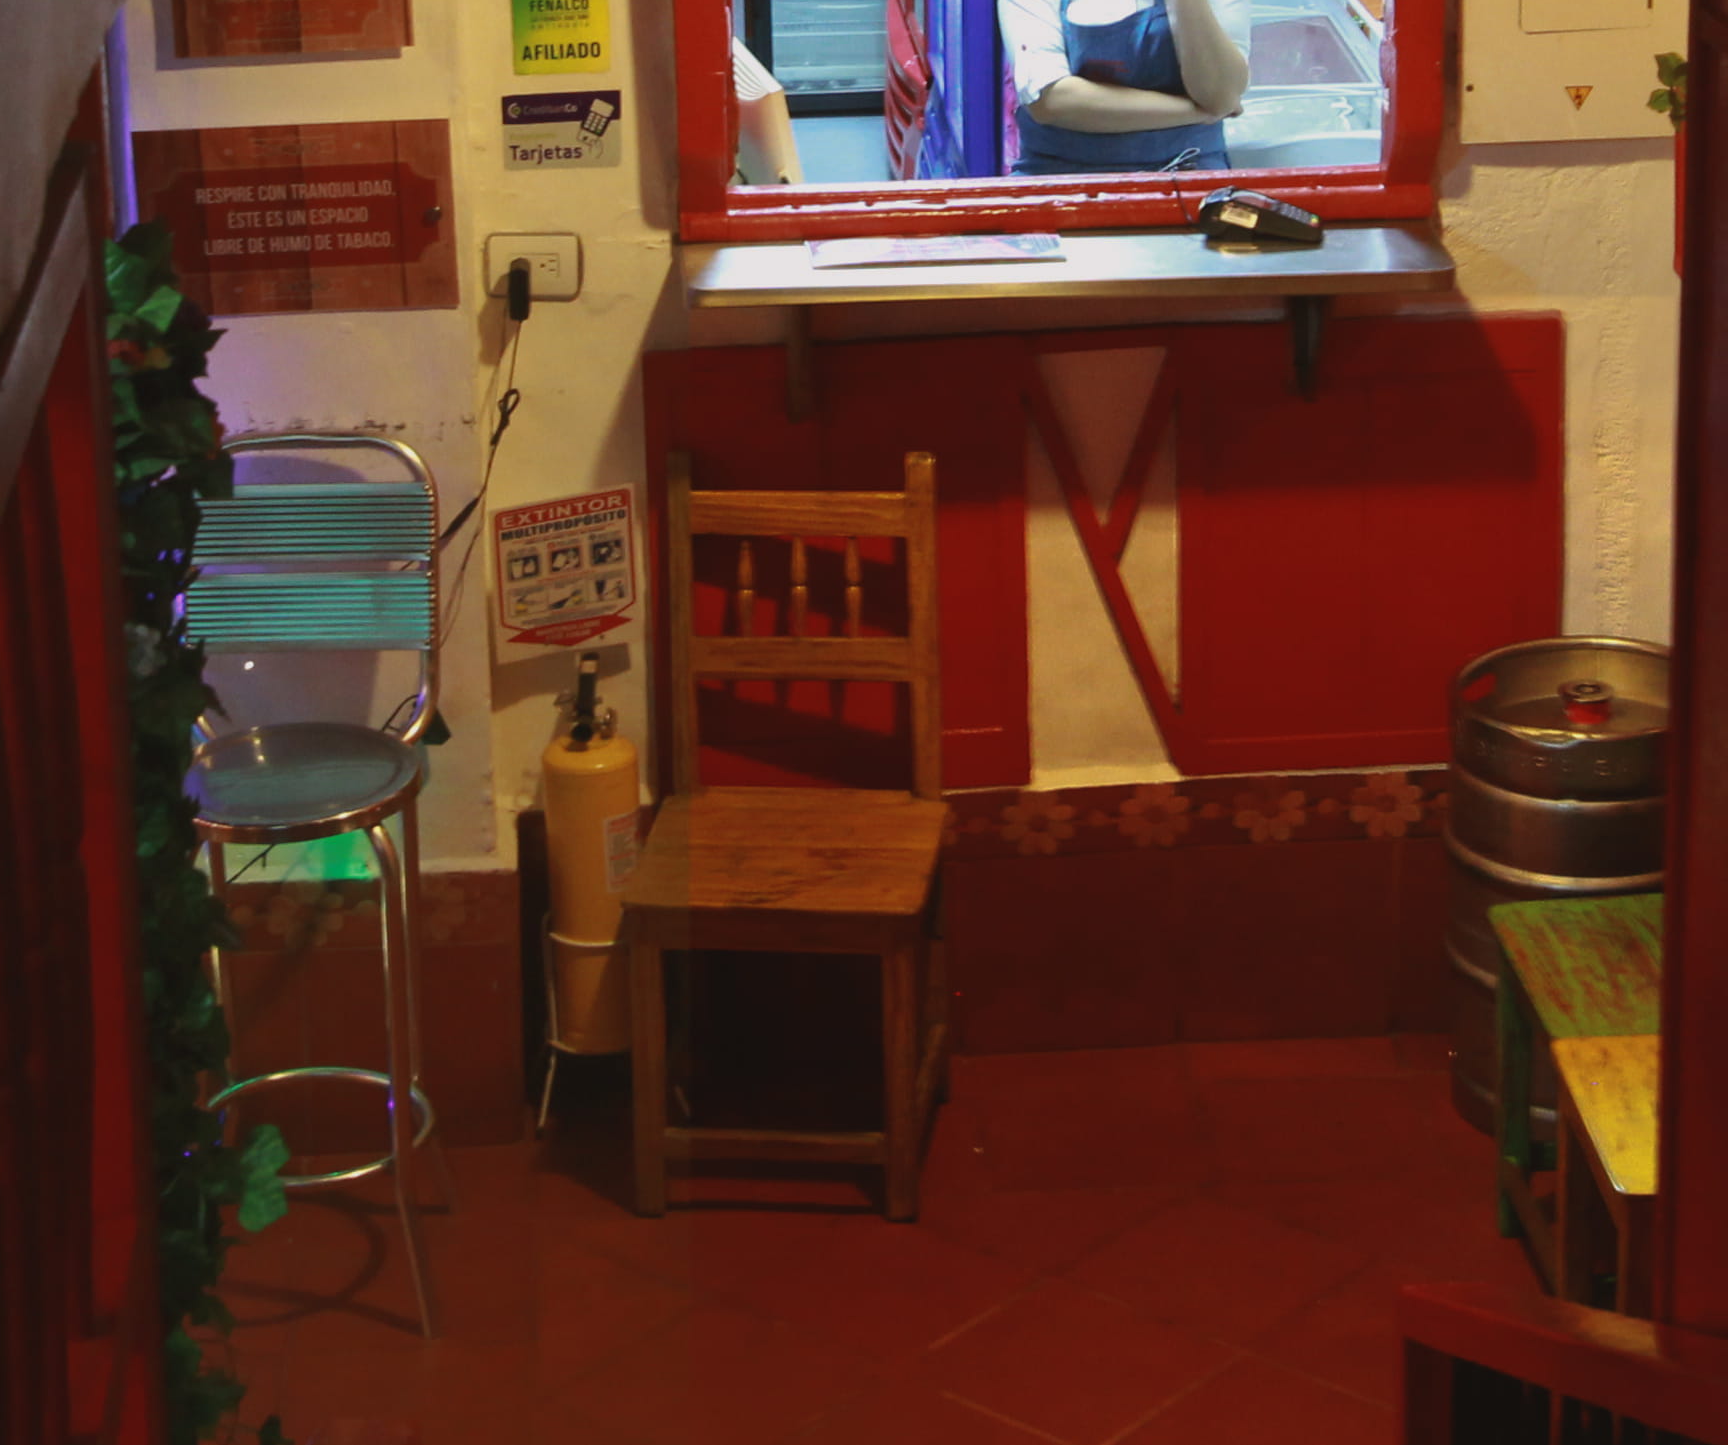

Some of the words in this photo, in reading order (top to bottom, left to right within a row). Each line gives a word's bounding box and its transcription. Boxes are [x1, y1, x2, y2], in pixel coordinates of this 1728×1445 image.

[522, 42, 601, 61] AFILIADO
[508, 144, 583, 165] Tarjetas
[195, 186, 255, 204] RESPIRE
[257, 185, 287, 201] CON
[265, 211, 283, 227] ES
[286, 210, 306, 226] UN
[310, 207, 368, 225] ESPACIO
[204, 238, 244, 256] LIBRE
[247, 238, 265, 254] DE
[269, 235, 311, 253] HUMO
[315, 234, 333, 251] DE
[501, 495, 622, 528] EXTINTOR
